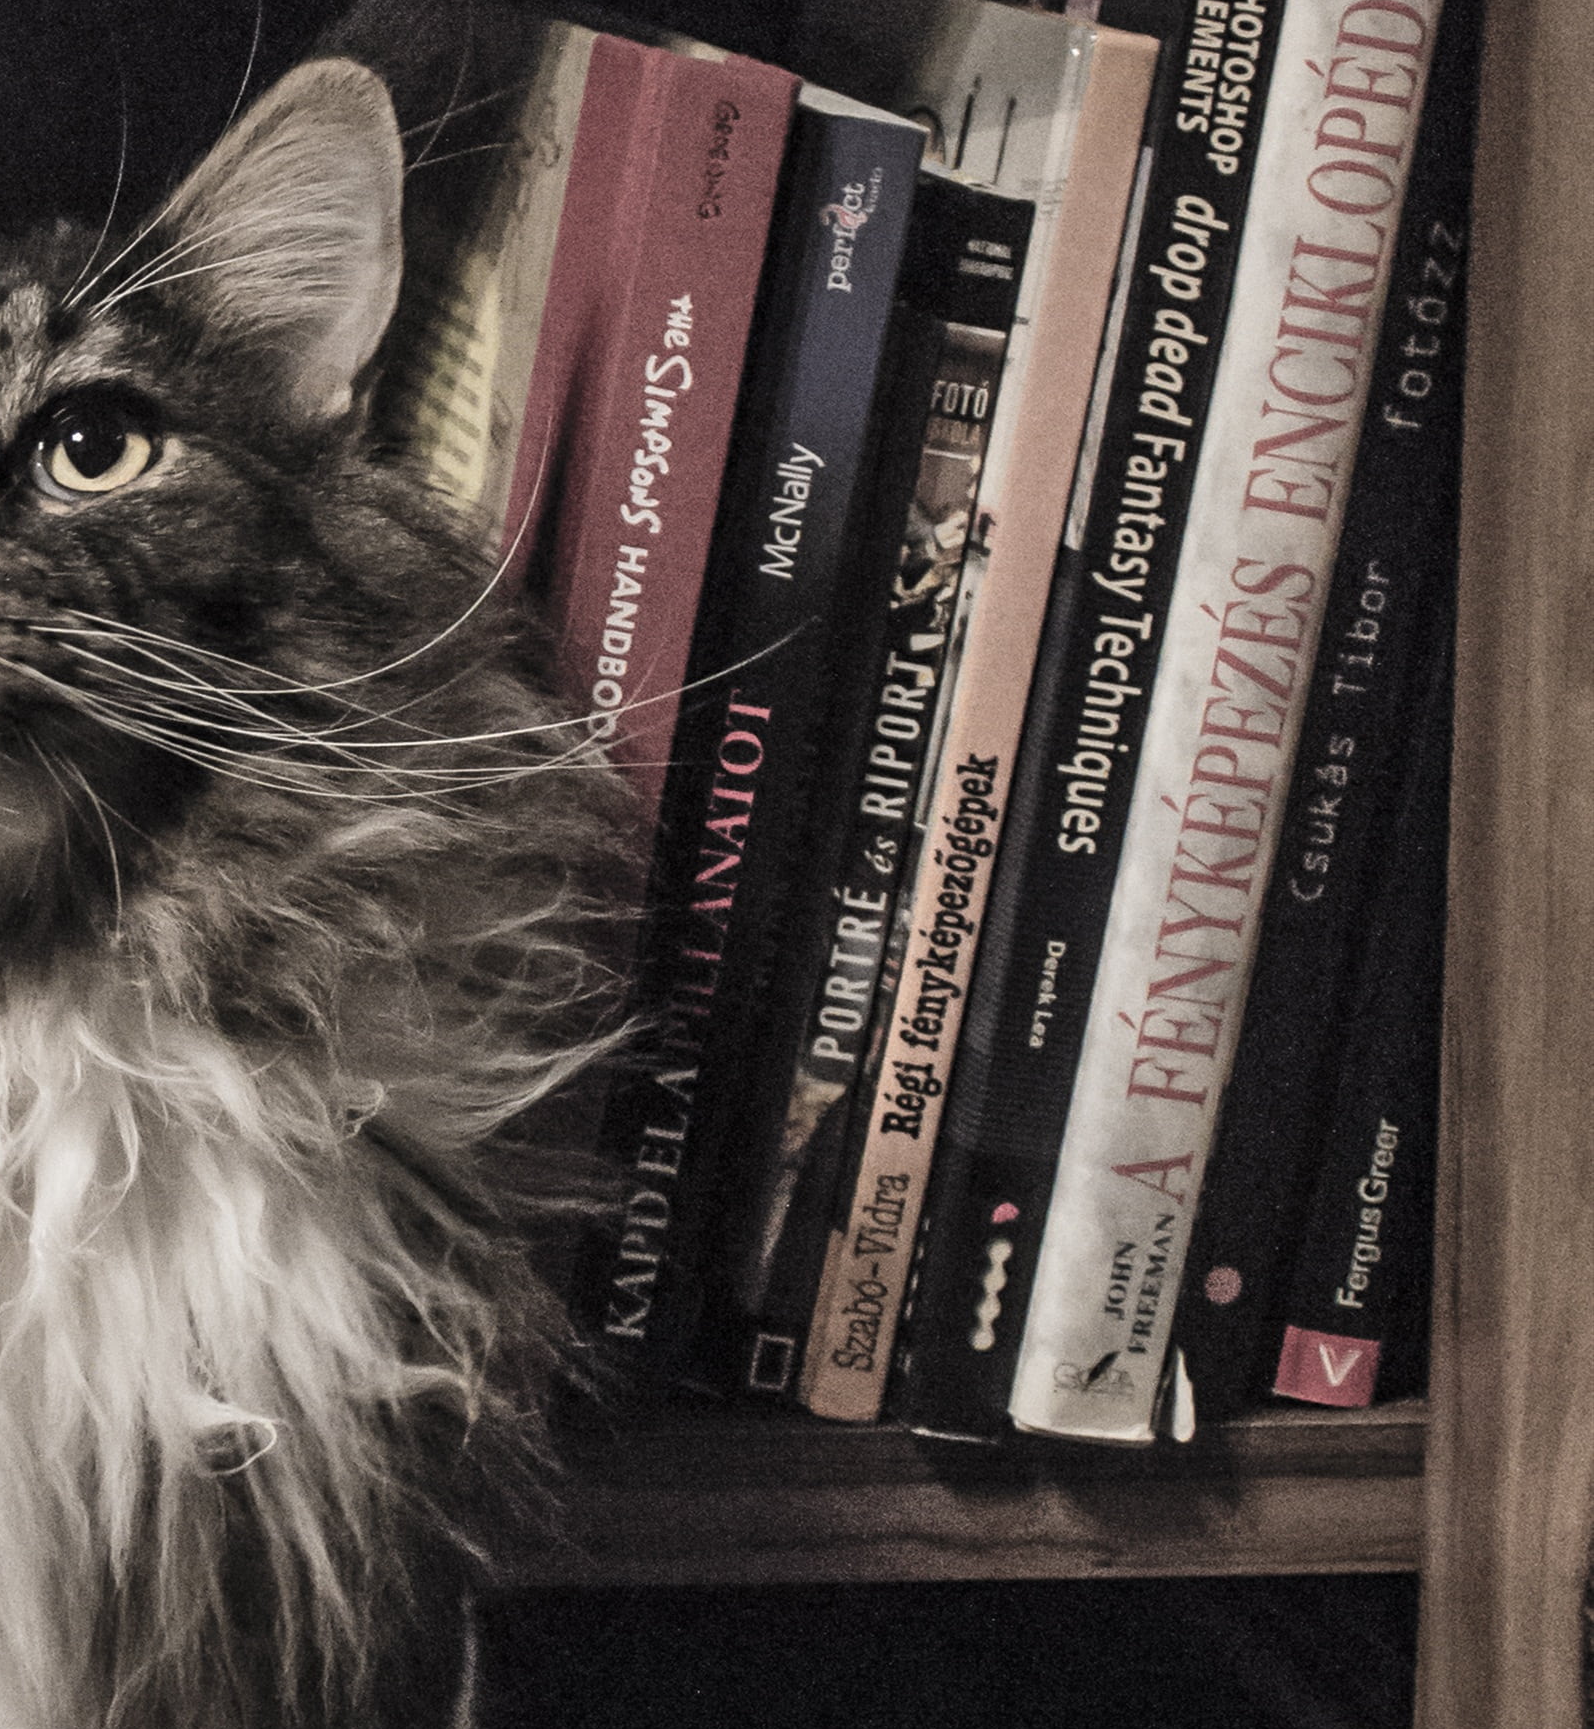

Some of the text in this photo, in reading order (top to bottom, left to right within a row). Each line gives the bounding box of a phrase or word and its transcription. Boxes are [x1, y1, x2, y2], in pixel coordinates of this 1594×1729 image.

[618, 354, 695, 536] SIMPSONS
[930, 380, 989, 419] FOTÓ
[758, 442, 828, 582] McNally
[1056, 192, 1230, 857] drop dead Fantasy Techniques
[1332, 559, 1394, 695] Tibor
[1117, 556, 1316, 1106] FÉNYKÉPEZÉS
[811, 882, 890, 1066] PORTRÉ
[864, 835, 898, 875] és
[1028, 938, 1068, 1050] Derek Lea
[830, 752, 1001, 1374] Szabó-Vidra Régi fényképezőgépek
[1111, 1151, 1195, 1207] A
[1334, 1116, 1403, 1310] Fergus Greer
[605, 1190, 668, 1338] KAPD
[1103, 1238, 1138, 1322] JOHN
[1126, 1211, 1177, 1356] FREEMAN
